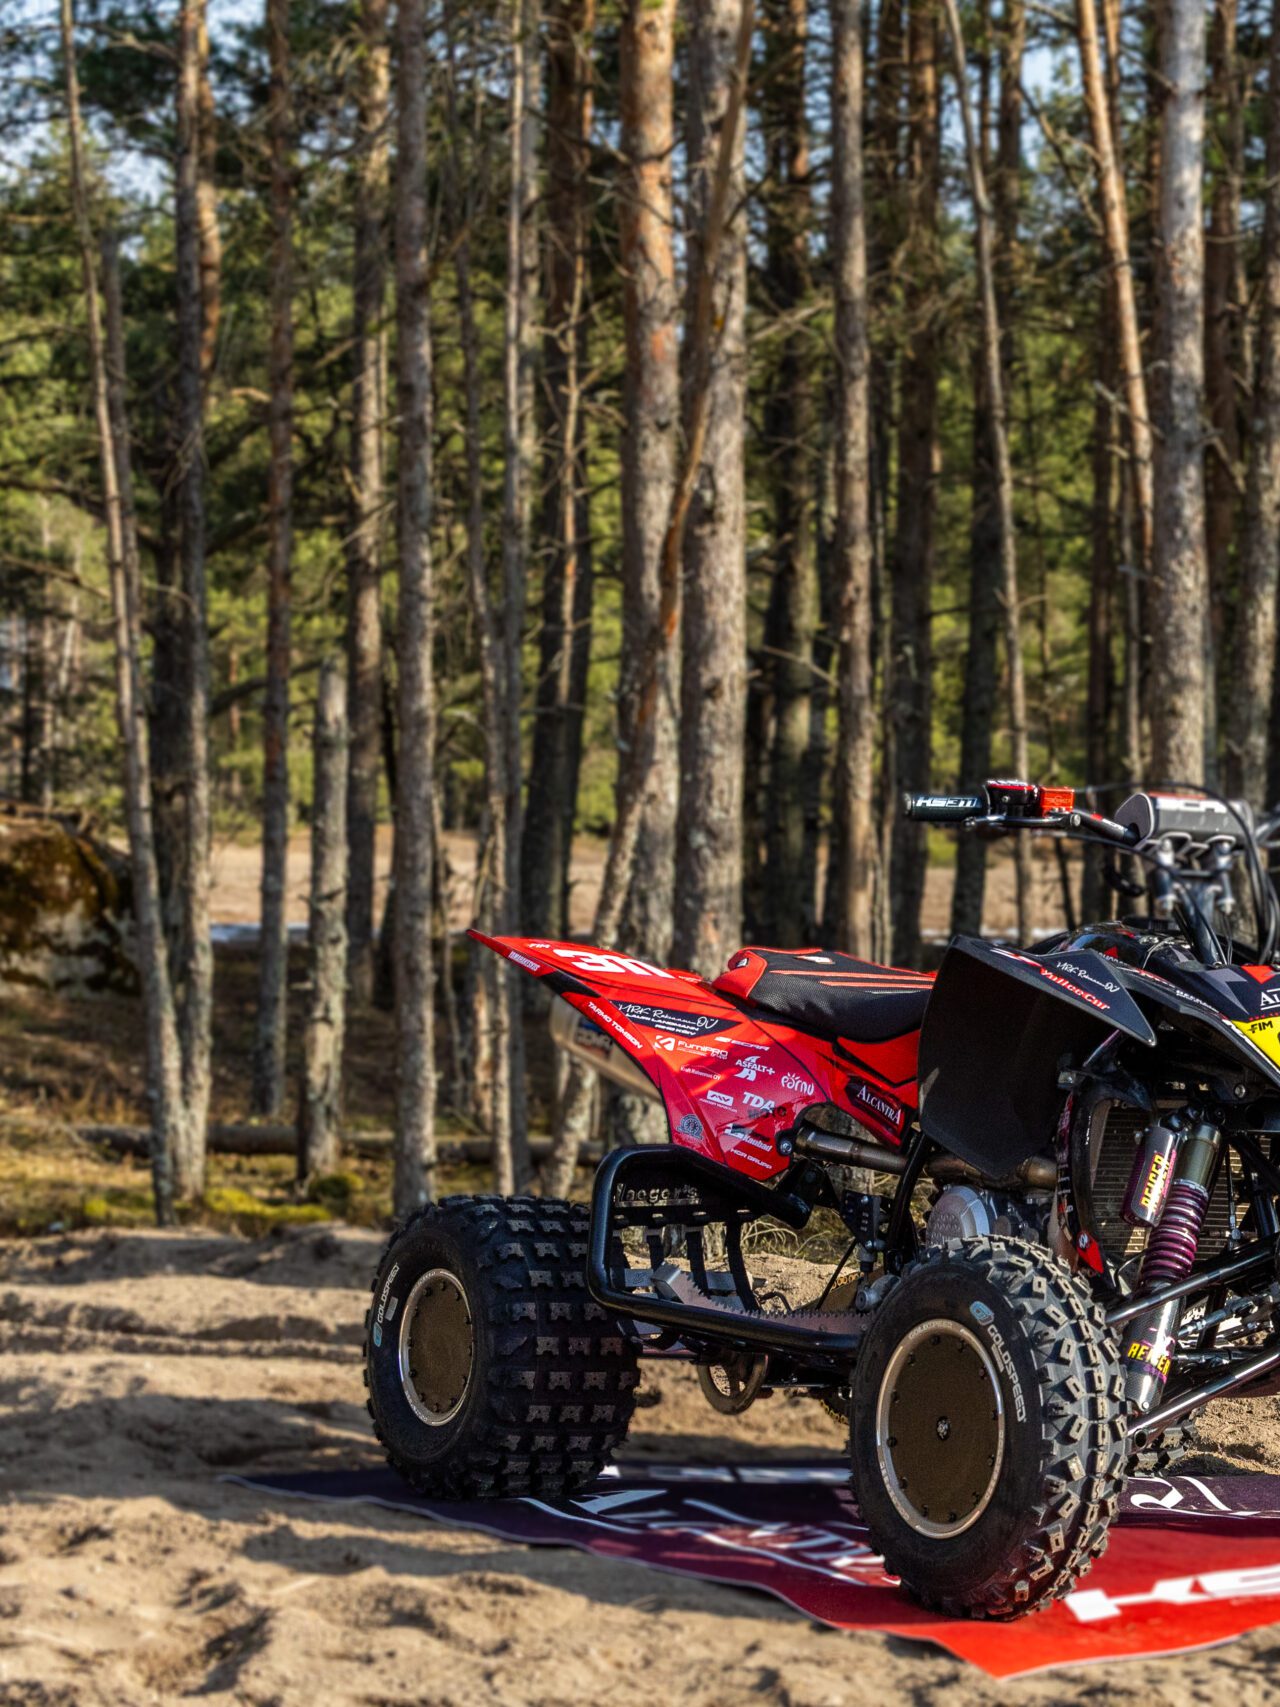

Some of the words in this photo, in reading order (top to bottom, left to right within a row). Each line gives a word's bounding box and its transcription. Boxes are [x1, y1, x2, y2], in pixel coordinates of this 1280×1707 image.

[553, 949, 675, 979] 311
[588, 1001, 613, 1023] TARMO
[612, 1020, 644, 1049] TOMSON
[1248, 1020, 1273, 1034] FIM
[742, 1091, 776, 1114] TDA
[857, 1085, 901, 1125] ALCANTRA
[377, 1262, 400, 1324] GOLDSPEED
[987, 1324, 1027, 1422] GOLDSPEED
[1127, 1343, 1171, 1375] REIER
